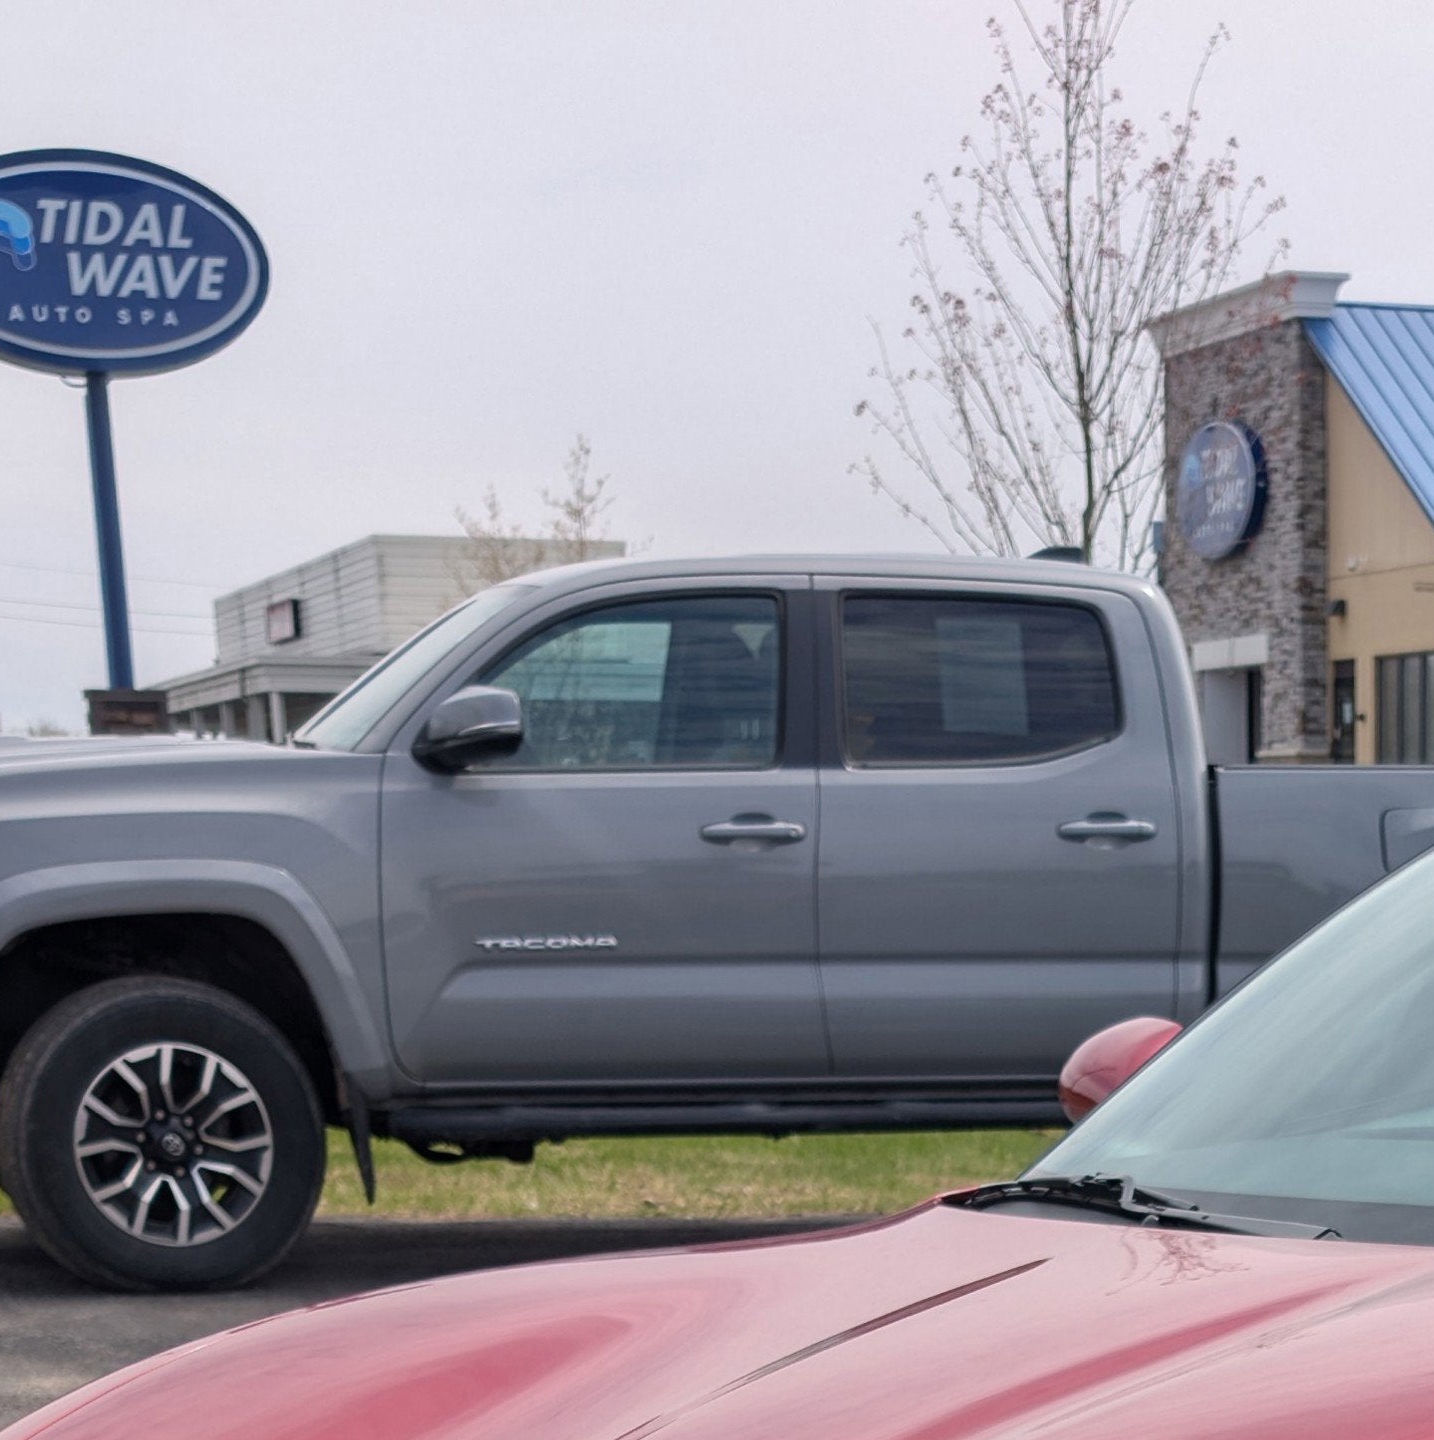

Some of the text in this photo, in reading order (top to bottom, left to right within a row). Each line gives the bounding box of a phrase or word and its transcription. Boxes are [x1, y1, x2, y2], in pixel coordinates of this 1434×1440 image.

[37, 199, 193, 249] TIDAL
[67, 252, 228, 301] WAVE
[8, 304, 180, 327] AUTO SPA
[473, 934, 618, 950] TACOMA
